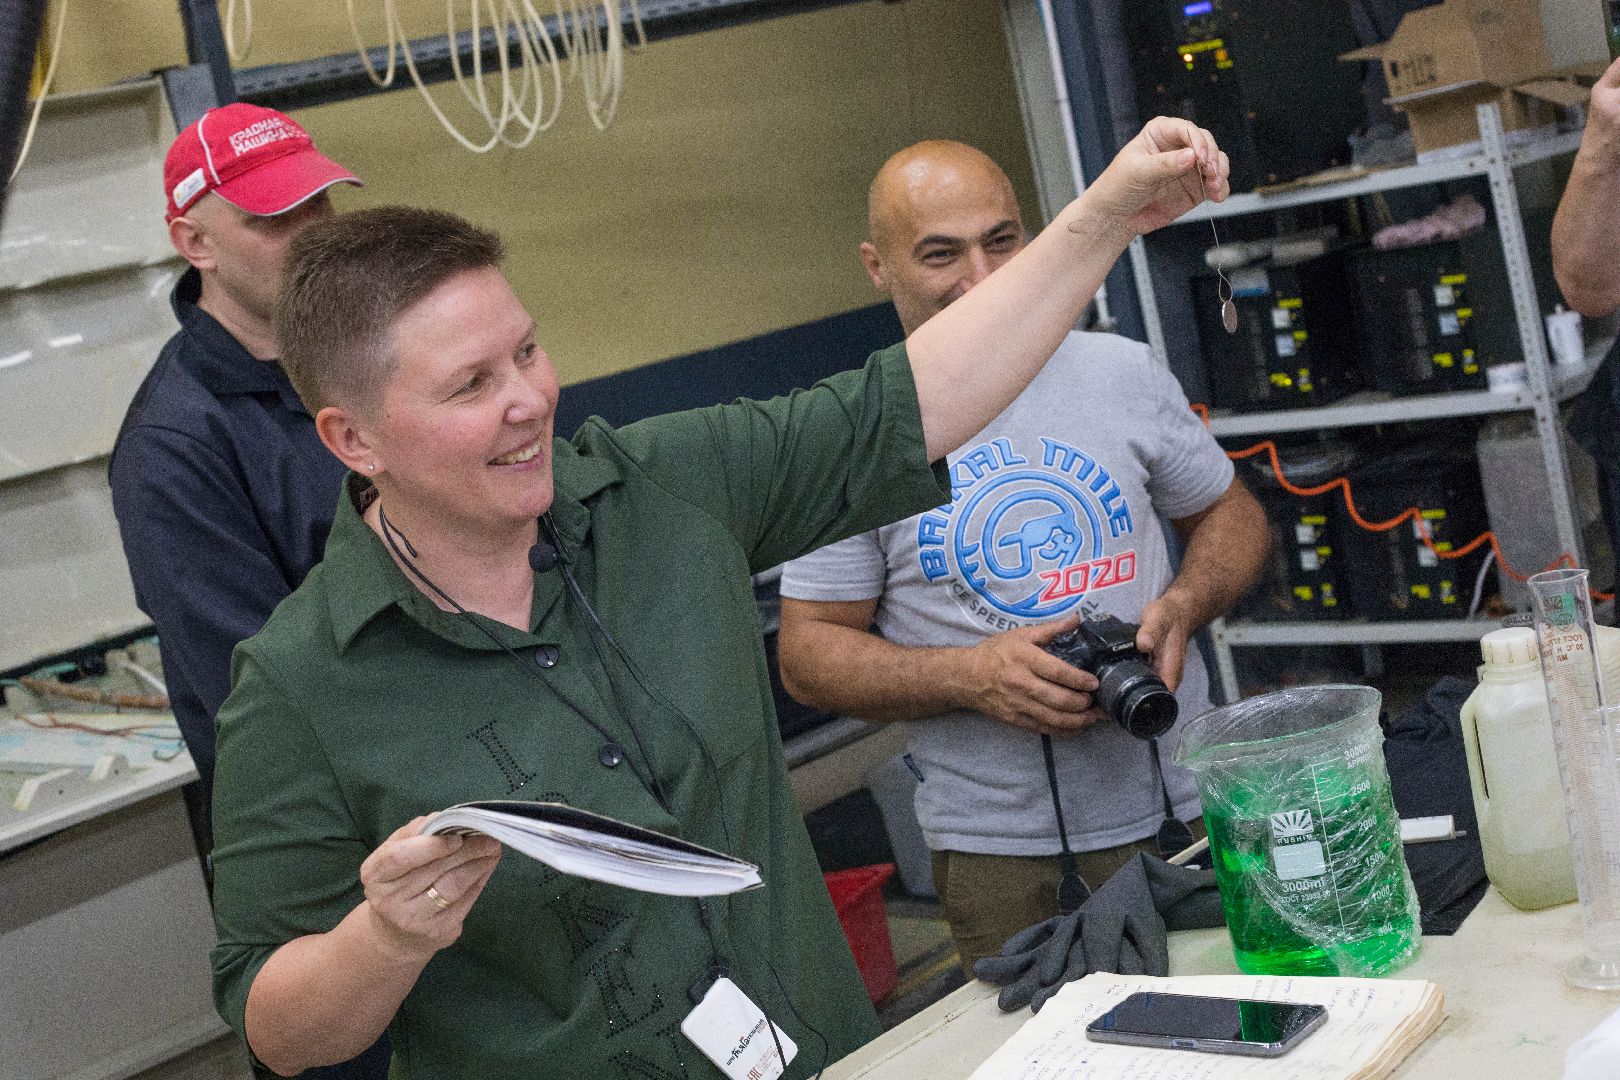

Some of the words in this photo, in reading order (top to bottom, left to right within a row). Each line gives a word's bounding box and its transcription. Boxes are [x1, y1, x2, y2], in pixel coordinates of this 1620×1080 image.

[1040, 437, 1133, 538] MILE
[1039, 551, 1136, 602] 2020
[968, 600, 1019, 631] SPEED
[1350, 779, 1371, 796] 2500
[1365, 850, 1385, 868] 1500
